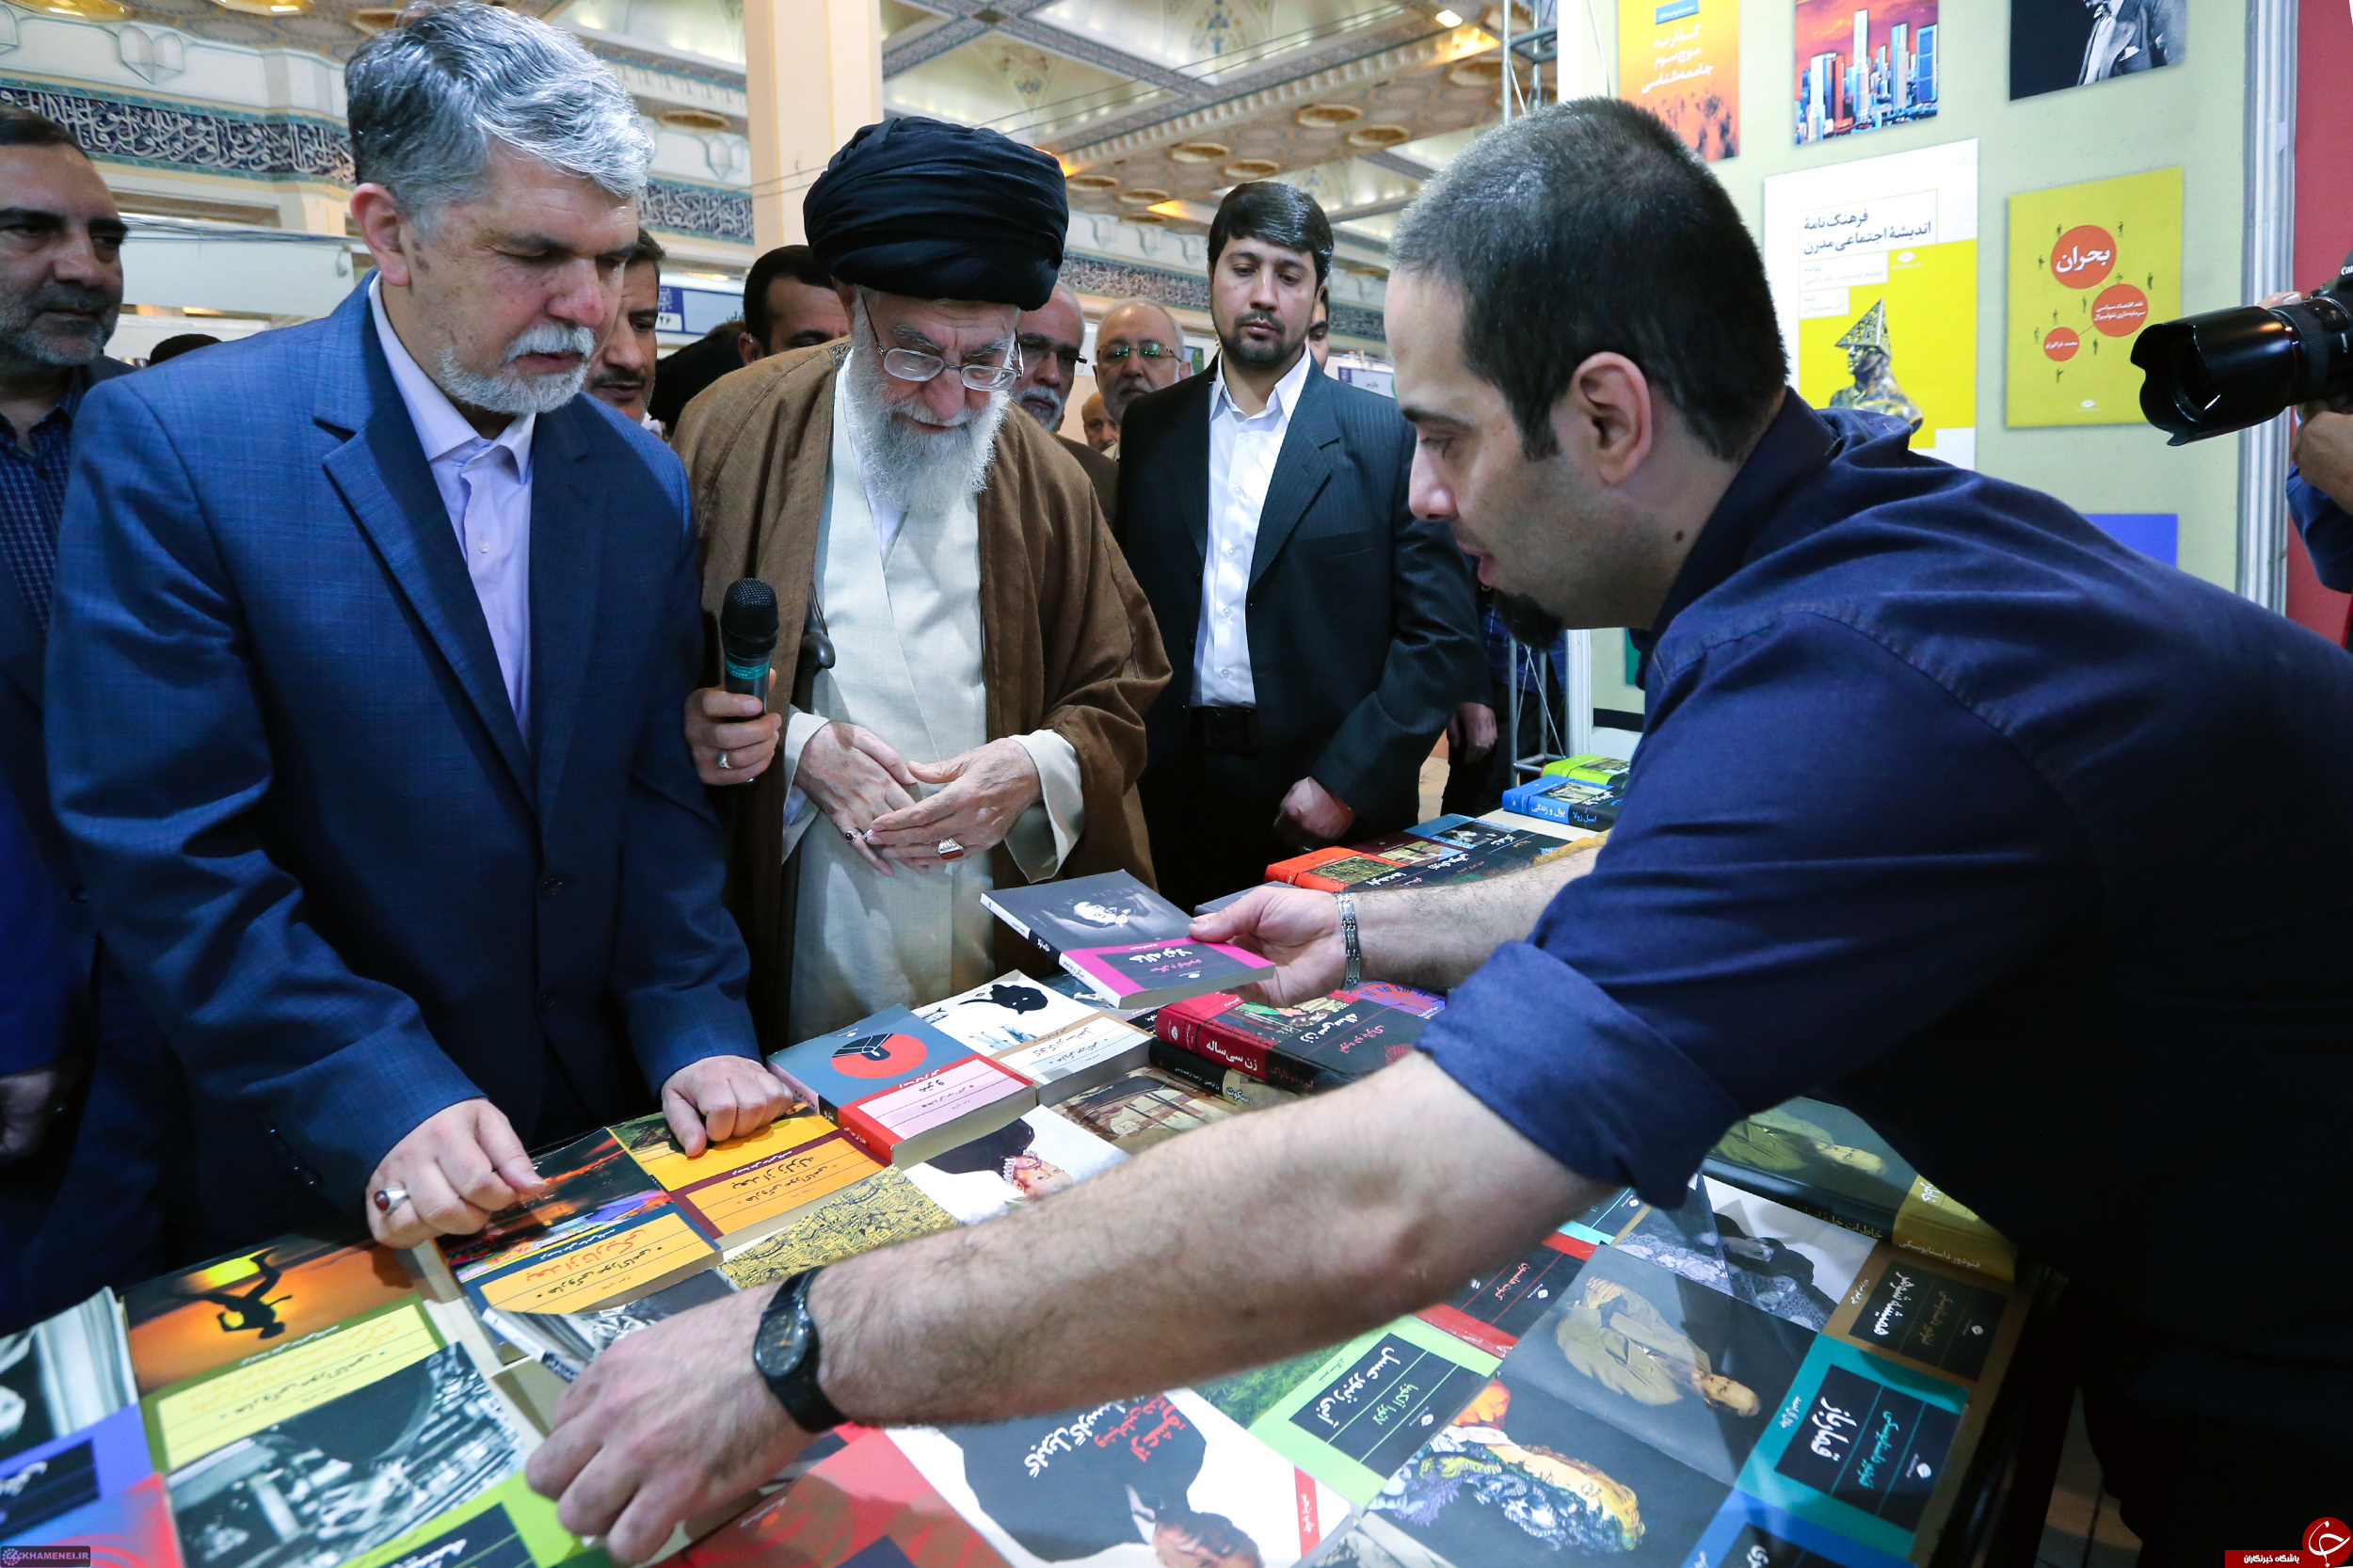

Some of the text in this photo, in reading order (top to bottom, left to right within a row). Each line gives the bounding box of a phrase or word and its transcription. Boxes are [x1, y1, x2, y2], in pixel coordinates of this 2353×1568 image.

[1653, 46, 1703, 72] موج سوم
[1803, 239, 1834, 256] مدرن
[1834, 227, 1887, 252] اجتماعی
[2055, 245, 2111, 274] بحران
[1530, 803, 1549, 816] زندگی
[1548, 808, 1554, 816] و
[1553, 807, 1566, 819] پول
[1128, 947, 1193, 964] خاله تولا
[1299, 1032, 1320, 1044] زن
[1243, 1057, 1258, 1072] زن
[730, 1156, 815, 1190] بعد از زلزله
[744, 1165, 828, 1202] هاروکی موراکامی
[1919, 1180, 1941, 1204] خاطر
[525, 1228, 647, 1282] بعد از تاریکی
[547, 1248, 652, 1295] هاروکی موراکامی
[1873, 1271, 1915, 1336] همیشه شوهر
[1315, 1346, 1401, 1430] آبی زنبور عسل
[1129, 1403, 1187, 1464] از عشق
[1810, 1396, 1858, 1462] قمارباز
[1023, 1426, 1072, 1479] گابریل
